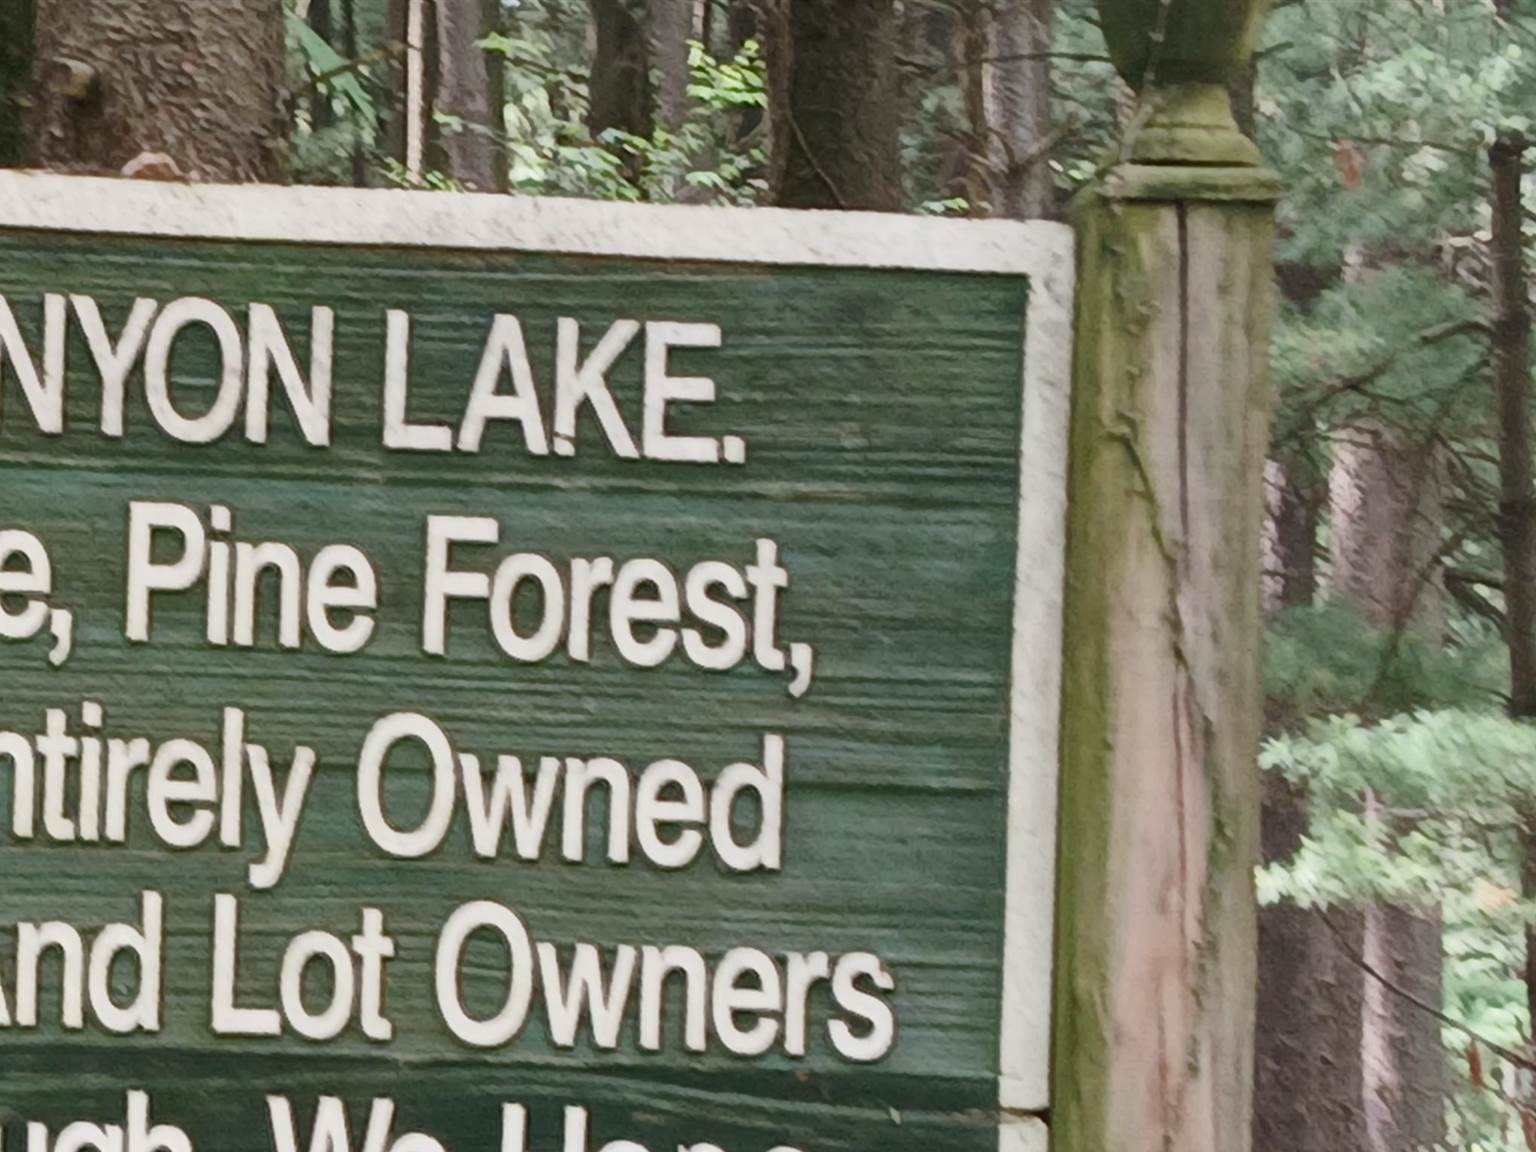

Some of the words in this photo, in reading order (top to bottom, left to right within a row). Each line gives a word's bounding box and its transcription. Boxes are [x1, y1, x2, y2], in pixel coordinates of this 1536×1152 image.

[382, 308, 746, 464] LAKE.
[124, 500, 378, 653] Pine
[422, 514, 813, 698] Forest,
[356, 711, 785, 871] Owned
[210, 892, 395, 1041] Lot
[434, 899, 895, 1061] Owners
